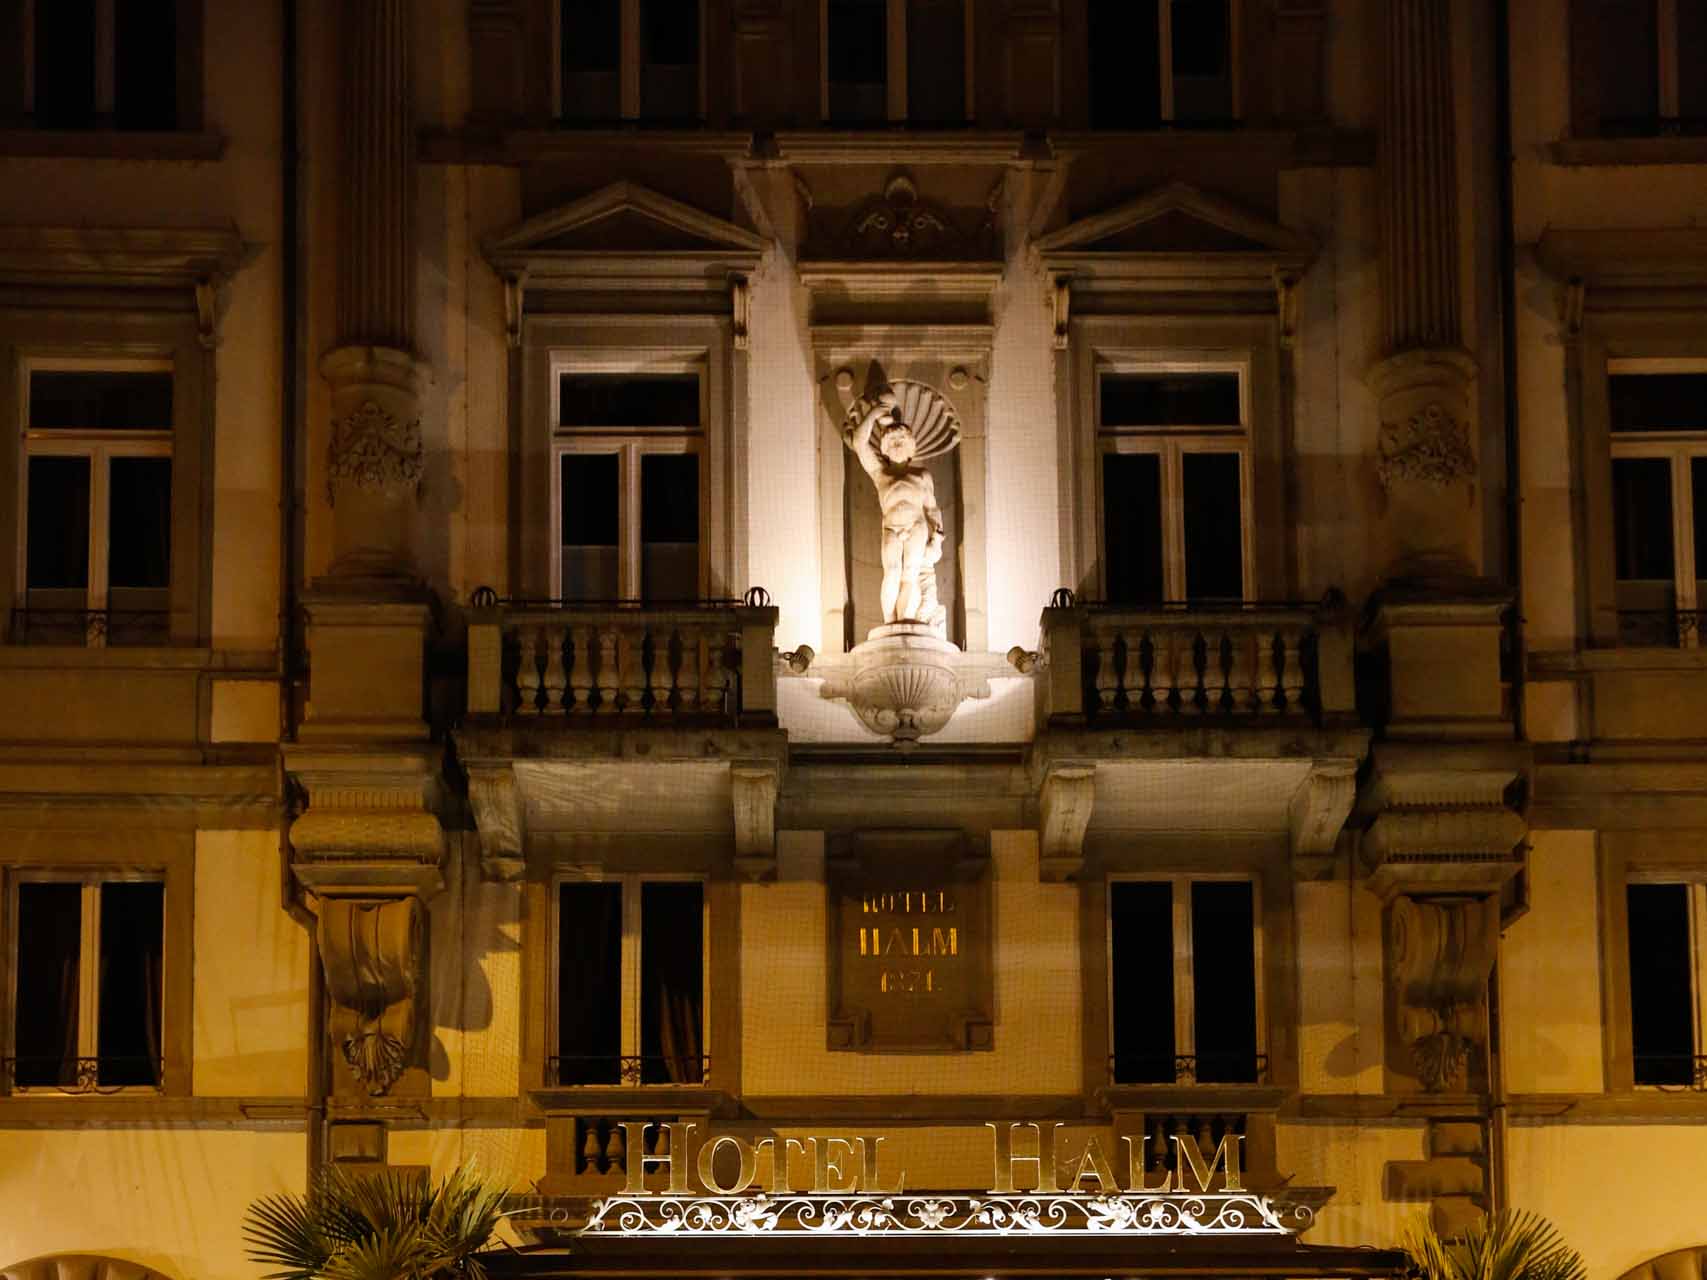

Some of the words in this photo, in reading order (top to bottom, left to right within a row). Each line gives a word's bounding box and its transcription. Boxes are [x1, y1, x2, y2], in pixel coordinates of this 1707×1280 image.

[859, 927, 958, 956] HALM
[617, 1121, 905, 1194] HOTEL
[984, 1121, 1249, 1193] HALM
